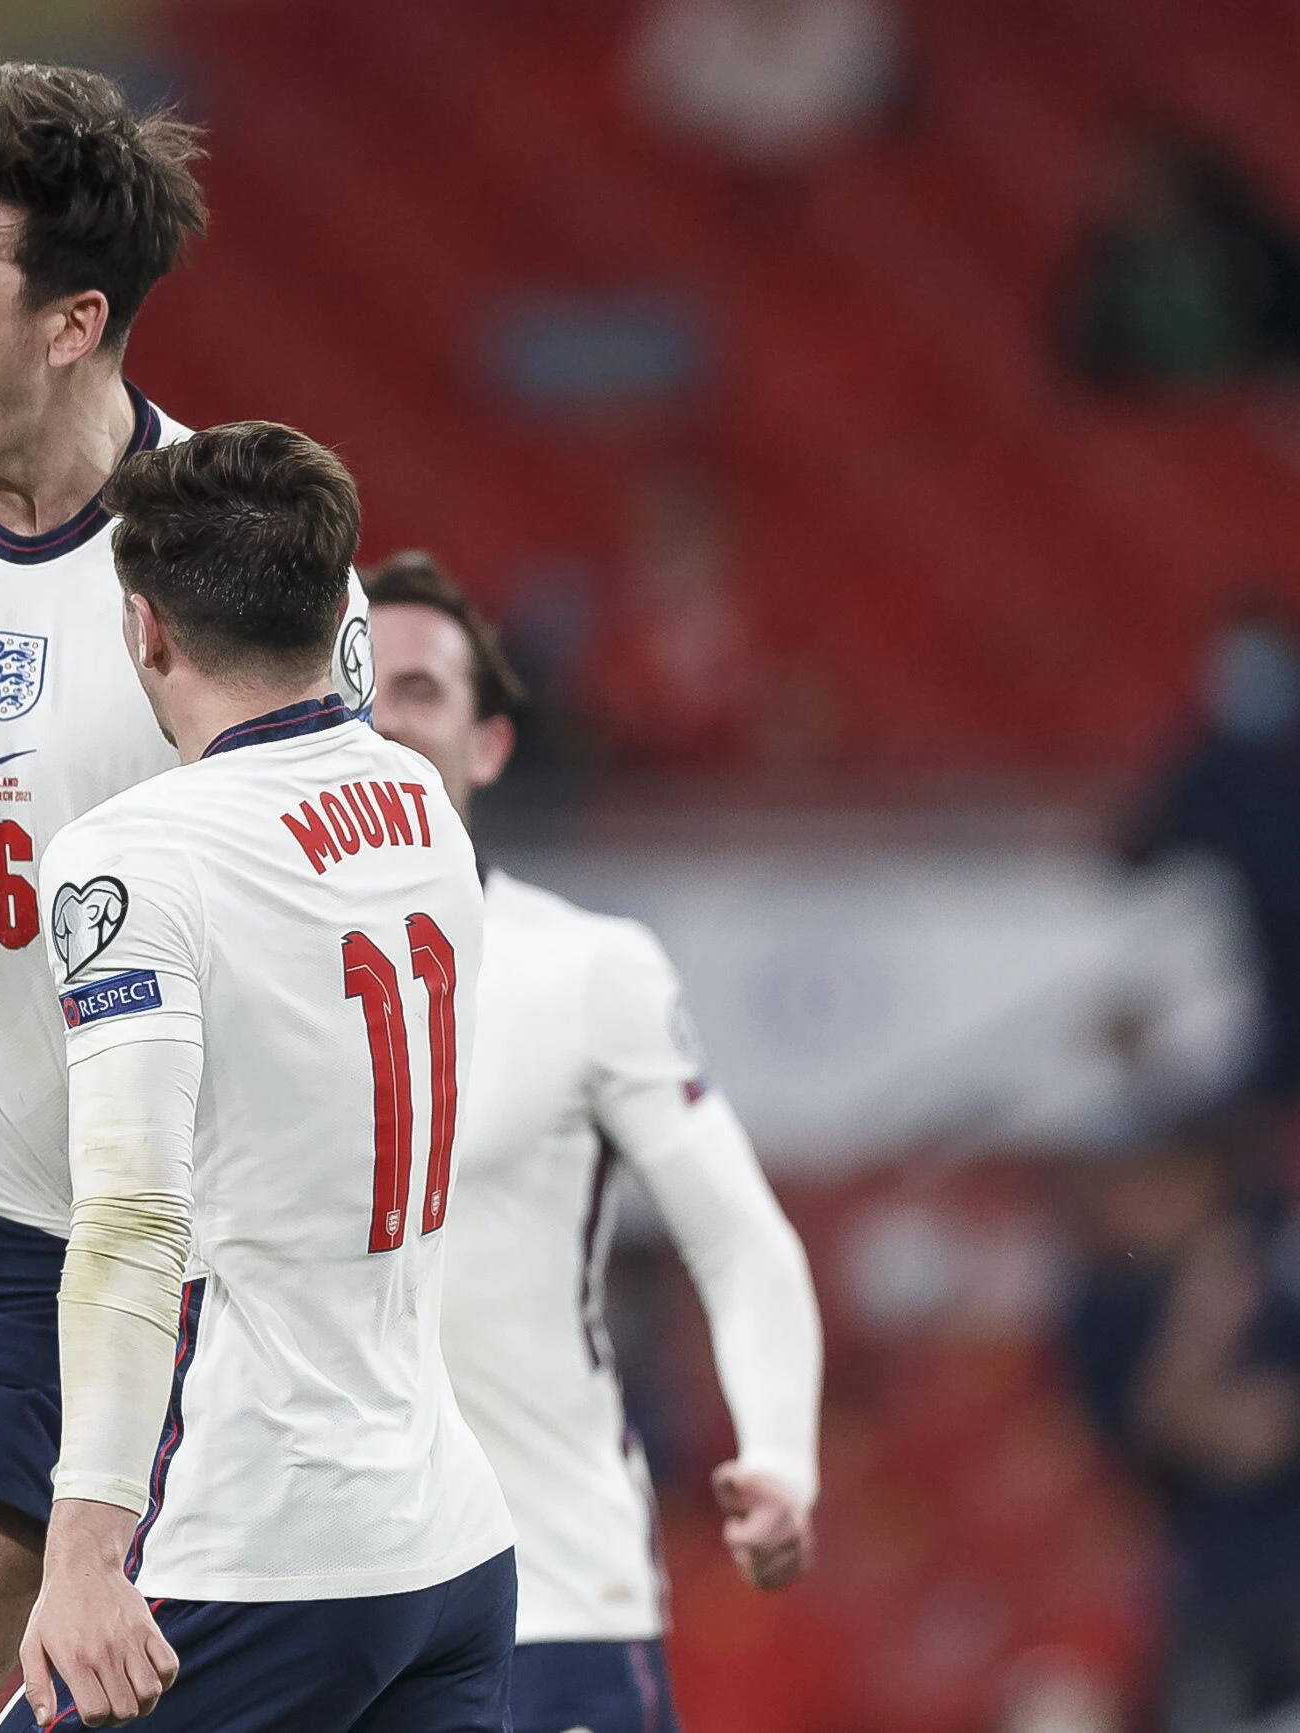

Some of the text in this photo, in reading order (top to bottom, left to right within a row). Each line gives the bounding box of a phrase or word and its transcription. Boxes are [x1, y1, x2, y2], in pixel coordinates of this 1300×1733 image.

[15, 790, 32, 802] 2021
[281, 781, 431, 875] MOUNT
[78, 979, 156, 1018] RESPECT
[340, 912, 457, 1254] 11
